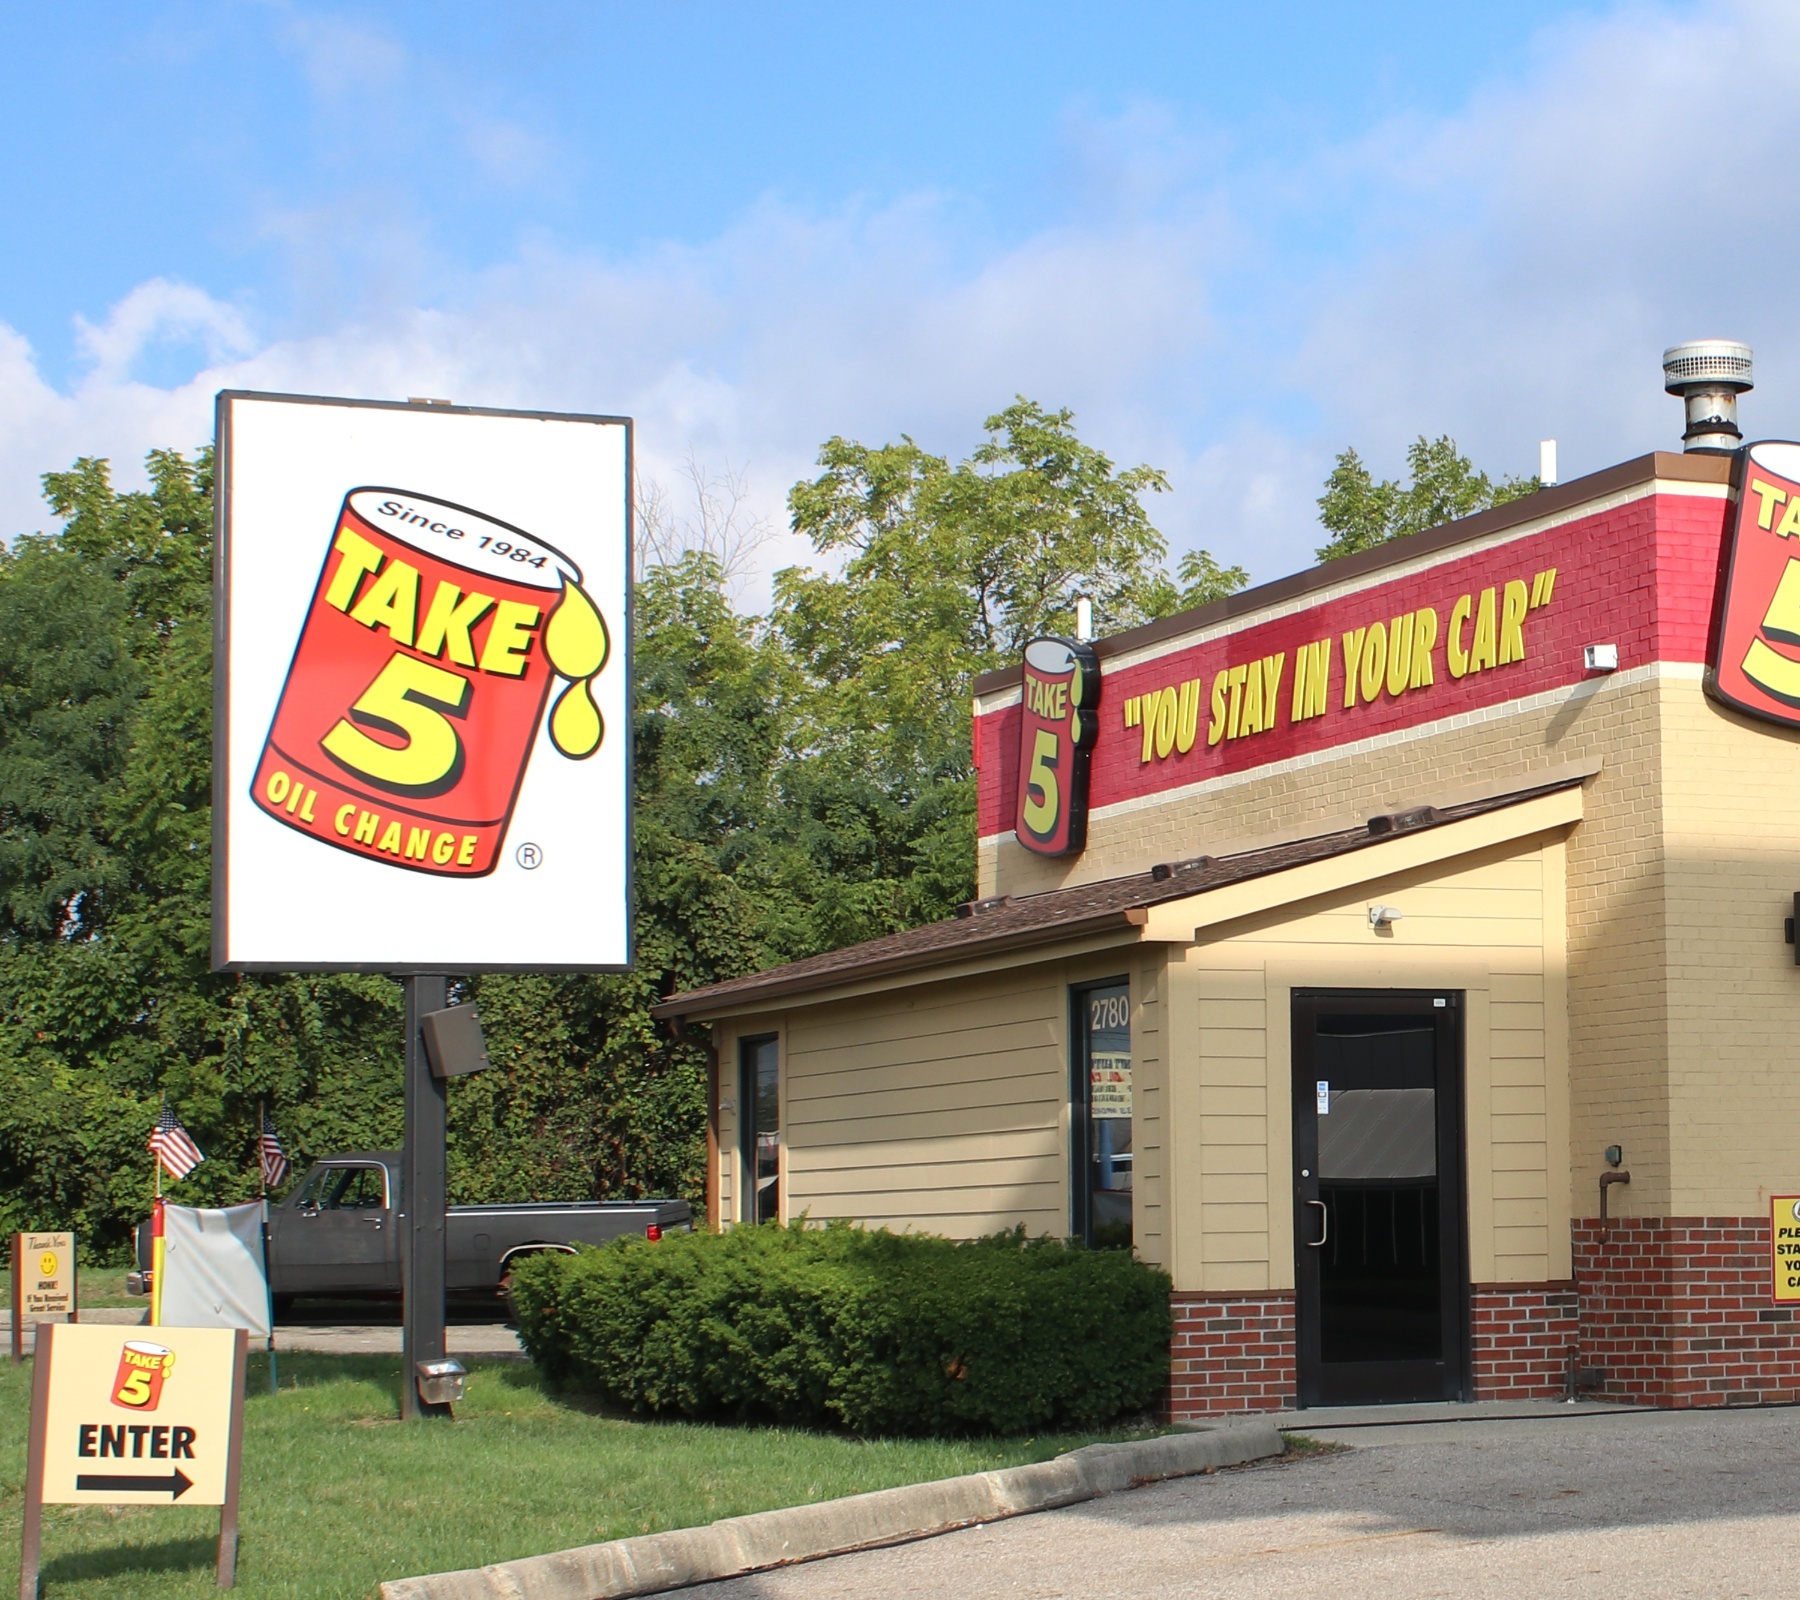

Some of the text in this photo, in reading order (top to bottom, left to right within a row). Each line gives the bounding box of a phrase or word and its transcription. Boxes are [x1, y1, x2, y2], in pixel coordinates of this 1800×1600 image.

[376, 500, 549, 570] Since 1984
[324, 526, 541, 679] TAKE
[1025, 673, 1068, 719] TAKE
[1207, 652, 1285, 746] STAY
[1291, 638, 1331, 722] IN
[1342, 607, 1437, 708] YOUR
[319, 650, 473, 797] 5
[1023, 728, 1059, 840] 5
[266, 771, 479, 868] OIL CHANGE
[1092, 996, 1129, 1030] 2780
[28, 1235, 66, 1250] Thank You
[117, 1369, 152, 1407] 5
[124, 1350, 161, 1369] TAKE
[78, 1424, 197, 1459] ENTER
